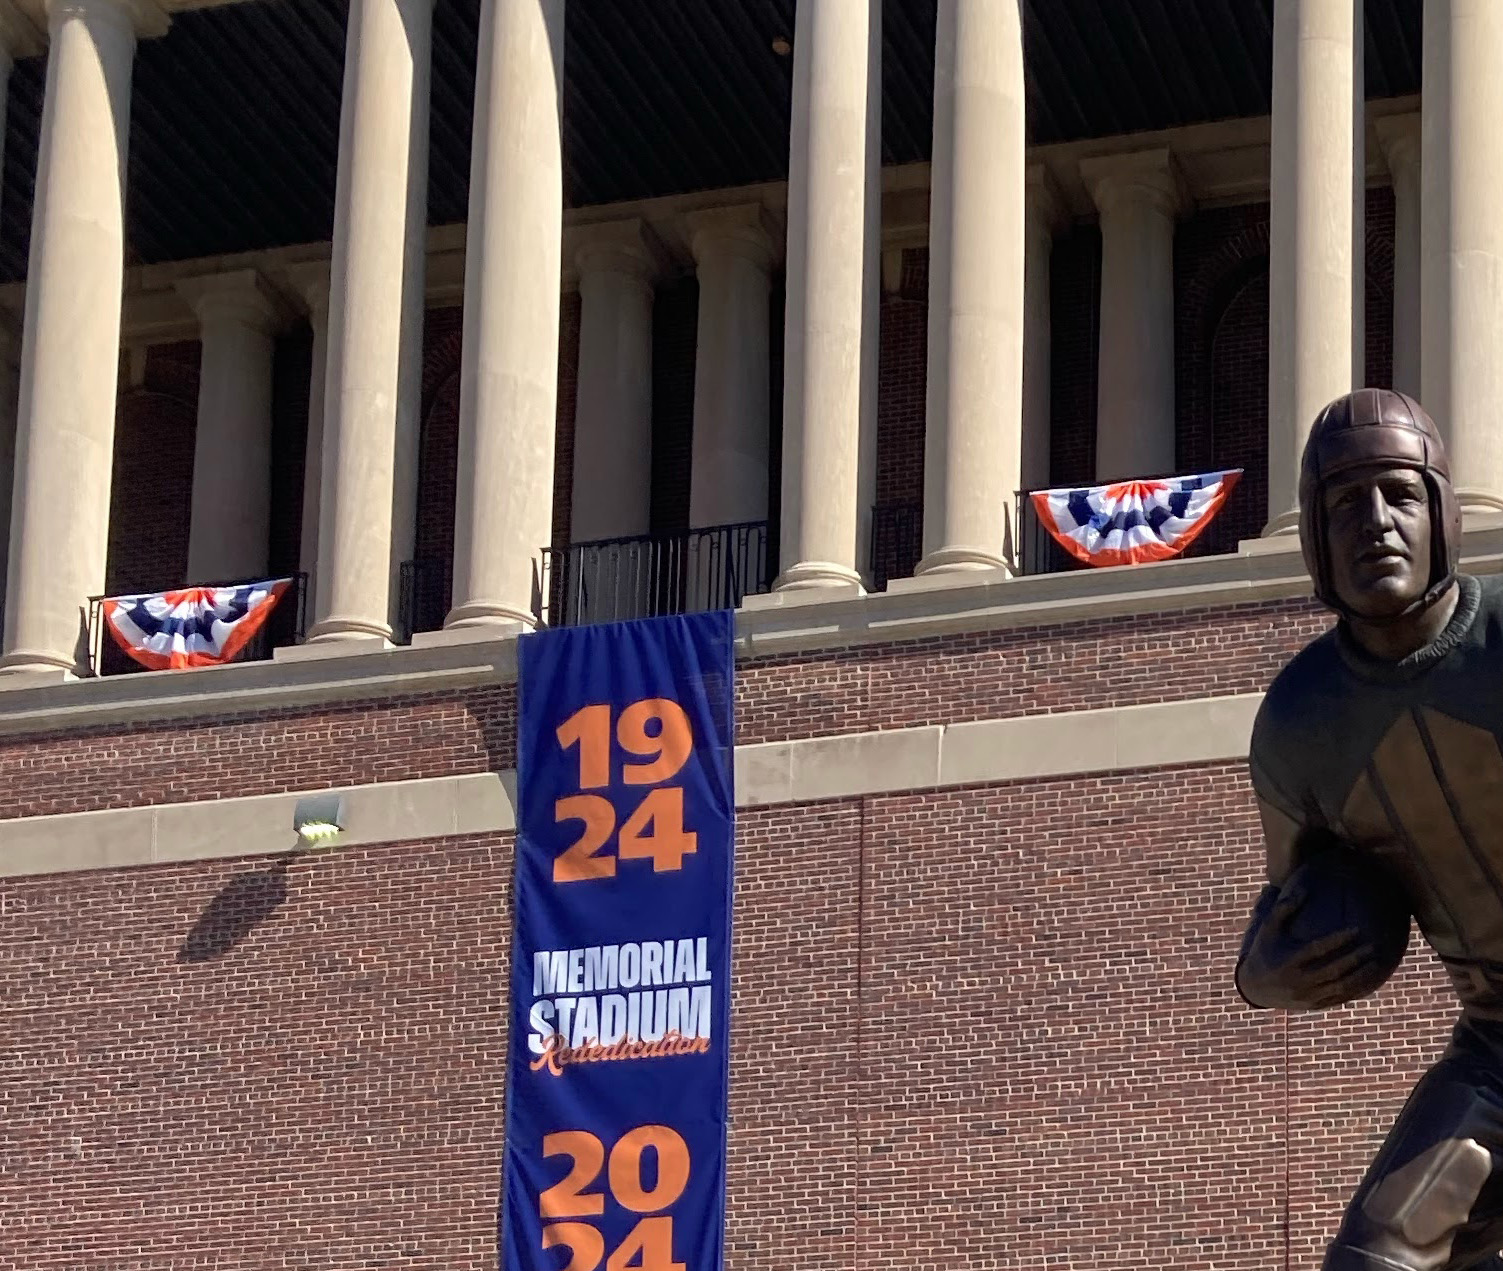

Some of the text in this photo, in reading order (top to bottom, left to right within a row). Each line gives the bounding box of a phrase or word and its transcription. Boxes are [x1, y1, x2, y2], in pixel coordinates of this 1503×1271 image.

[555, 698, 693, 789] 19
[553, 787, 697, 883] 24
[533, 937, 712, 997] MEMORIAL
[528, 985, 712, 1054] STADIUM
[530, 1028, 711, 1077] Rededication
[539, 1124, 690, 1218] 20
